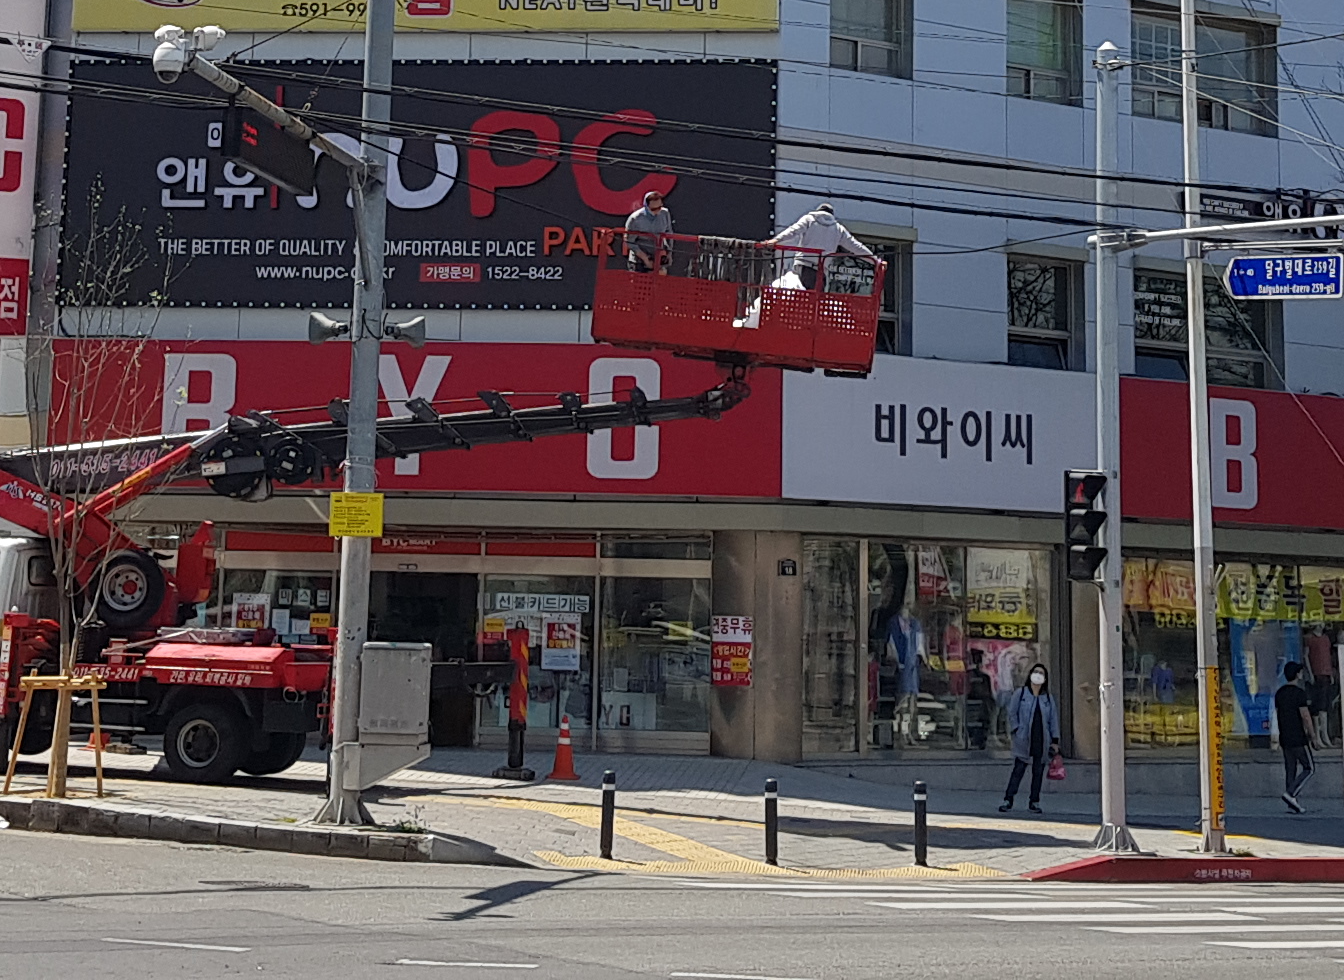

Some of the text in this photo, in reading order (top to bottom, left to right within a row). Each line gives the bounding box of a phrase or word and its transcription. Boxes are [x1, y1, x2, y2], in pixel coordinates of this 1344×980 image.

[298, 2, 368, 18] 591-99
[158, 237, 536, 258] THE BETTER OF QUALITY OMFORTABLE PLACE
[425, 266, 475, 280] 가맹문의
[486, 266, 563, 280] 1522-8422
[1265, 259, 1337, 280] 달구벌대로259길
[873, 402, 1035, 466] 비와이씨
[498, 594, 589, 612] 선불카드가능
